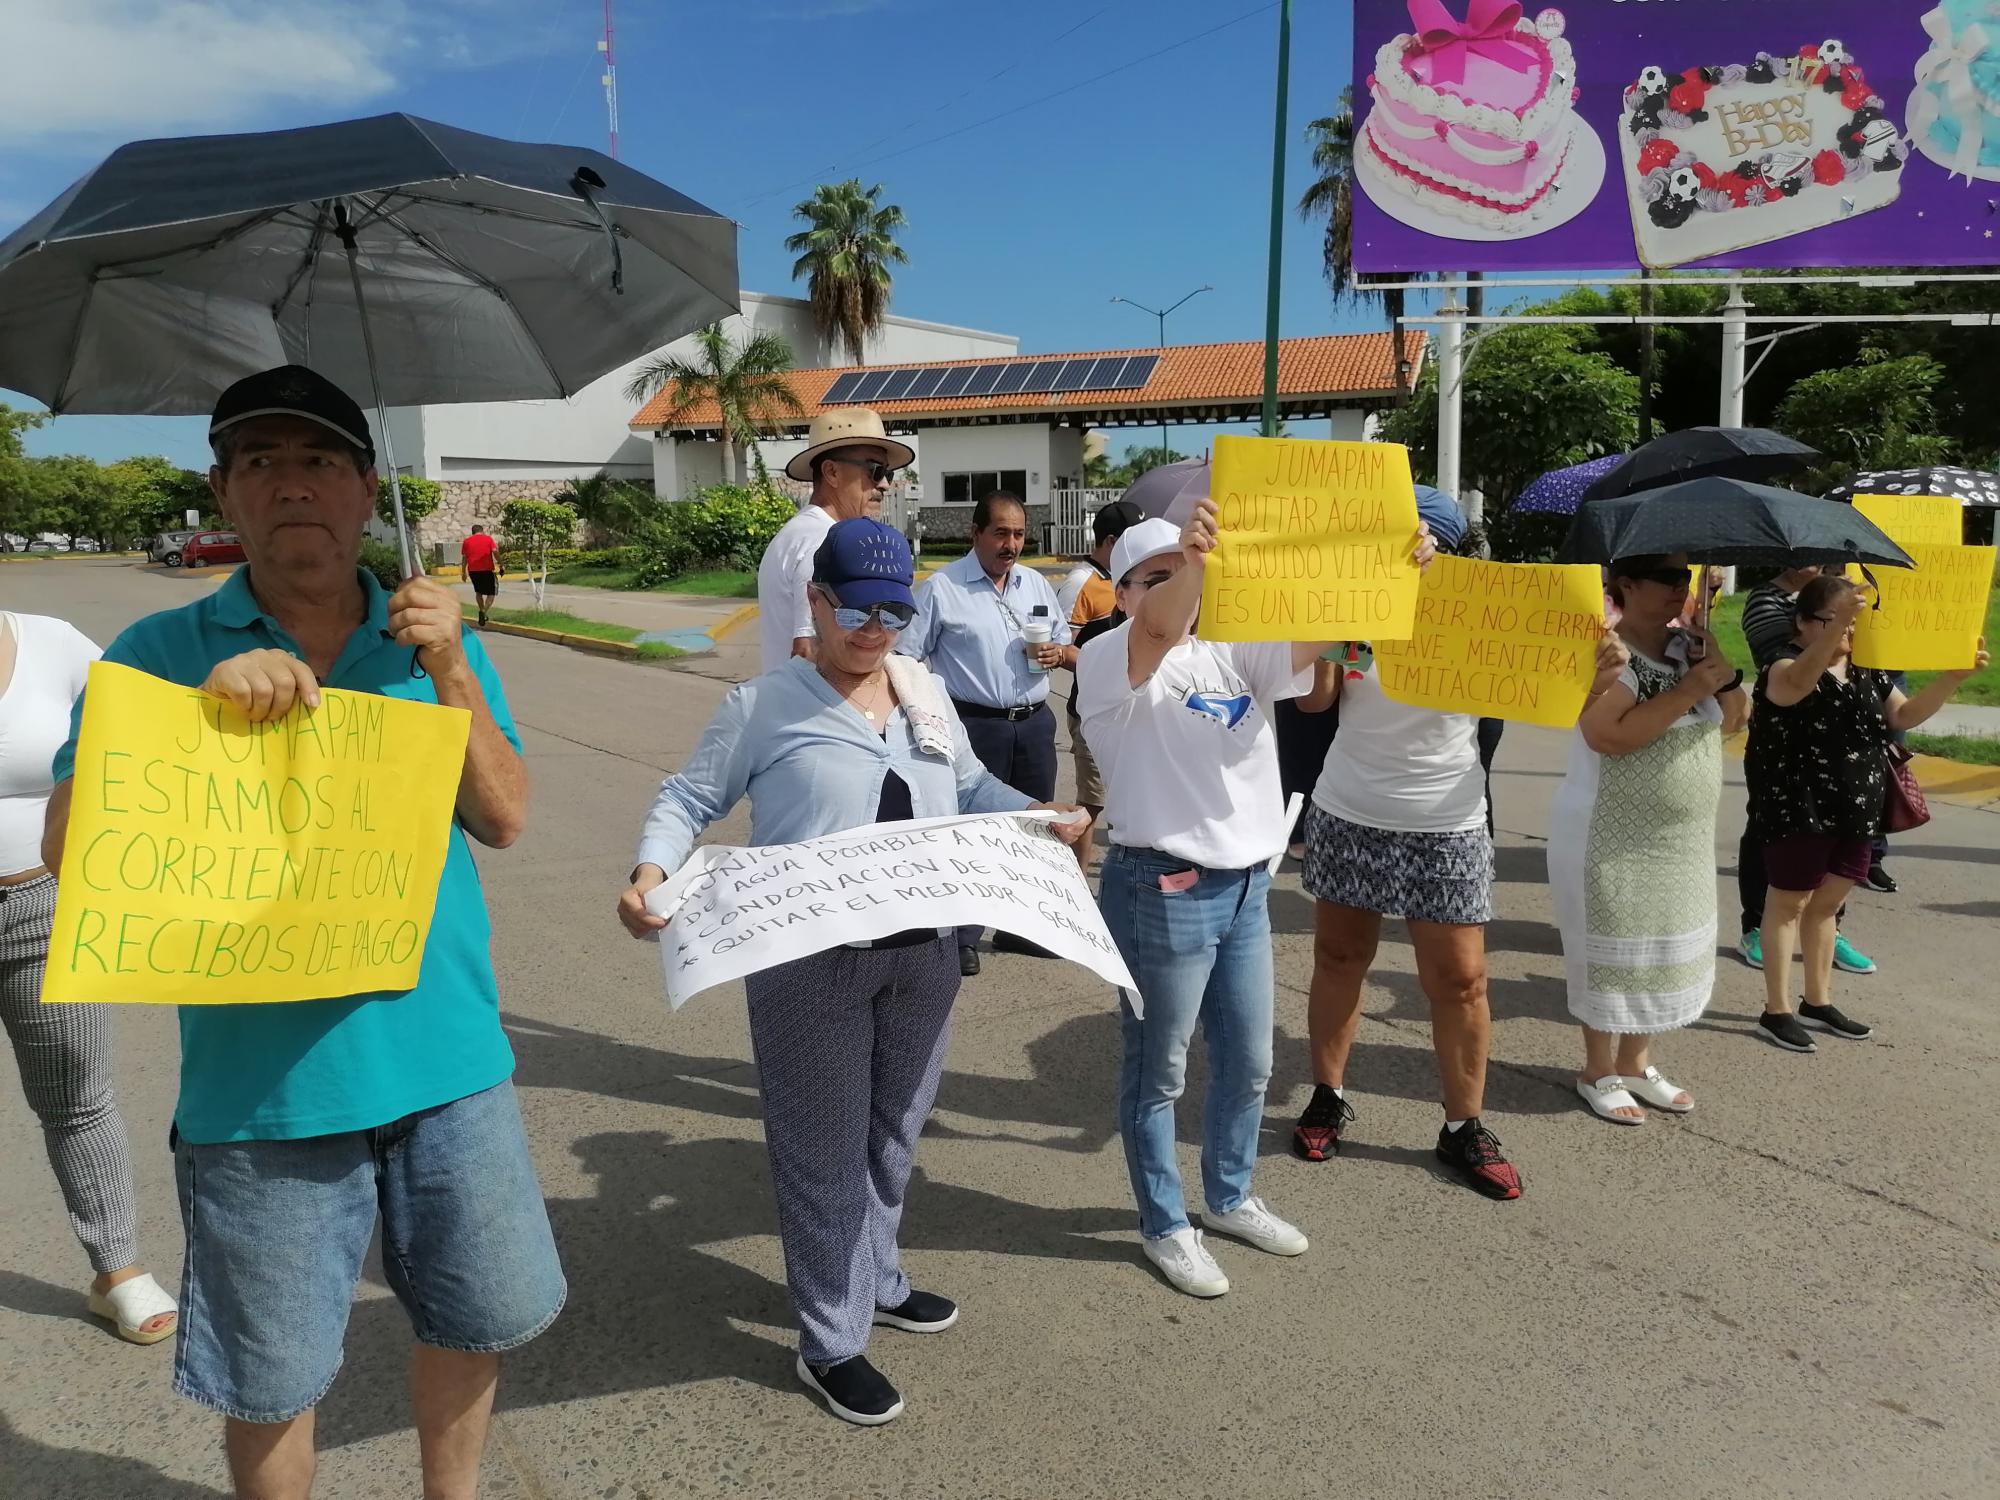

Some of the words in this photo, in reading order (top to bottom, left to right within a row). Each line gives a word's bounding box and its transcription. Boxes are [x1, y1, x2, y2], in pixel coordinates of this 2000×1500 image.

[1714, 92, 1806, 124] Happy
[1266, 444, 1385, 490] JUMAPAM
[1222, 492, 1318, 534] QUITAR
[1325, 497, 1386, 535] AGUA
[1221, 543, 1322, 580] LIQUIDO
[1333, 543, 1402, 580] VITAL
[1426, 557, 1564, 601] JUMAPAM
[1215, 588, 1249, 624] ES
[1260, 588, 1295, 624] UN
[1306, 588, 1392, 624] DELITO
[1480, 604, 1518, 632] NO
[1466, 638, 1577, 677] MENTIRA
[176, 693, 386, 766] JUMAPAM
[102, 751, 336, 835] ESTAMOS
[351, 778, 376, 833] AL
[82, 829, 344, 902] CORRIENTE
[352, 849, 413, 899] CON
[684, 898, 718, 928] DE
[734, 858, 806, 892] AGUA
[817, 830, 938, 867] POTABLE
[952, 829, 974, 847] A
[949, 858, 991, 875] DE
[846, 893, 889, 912] EL
[71, 907, 300, 979] RECIBOS
[305, 921, 346, 978] DE
[350, 919, 420, 970] PAGO
